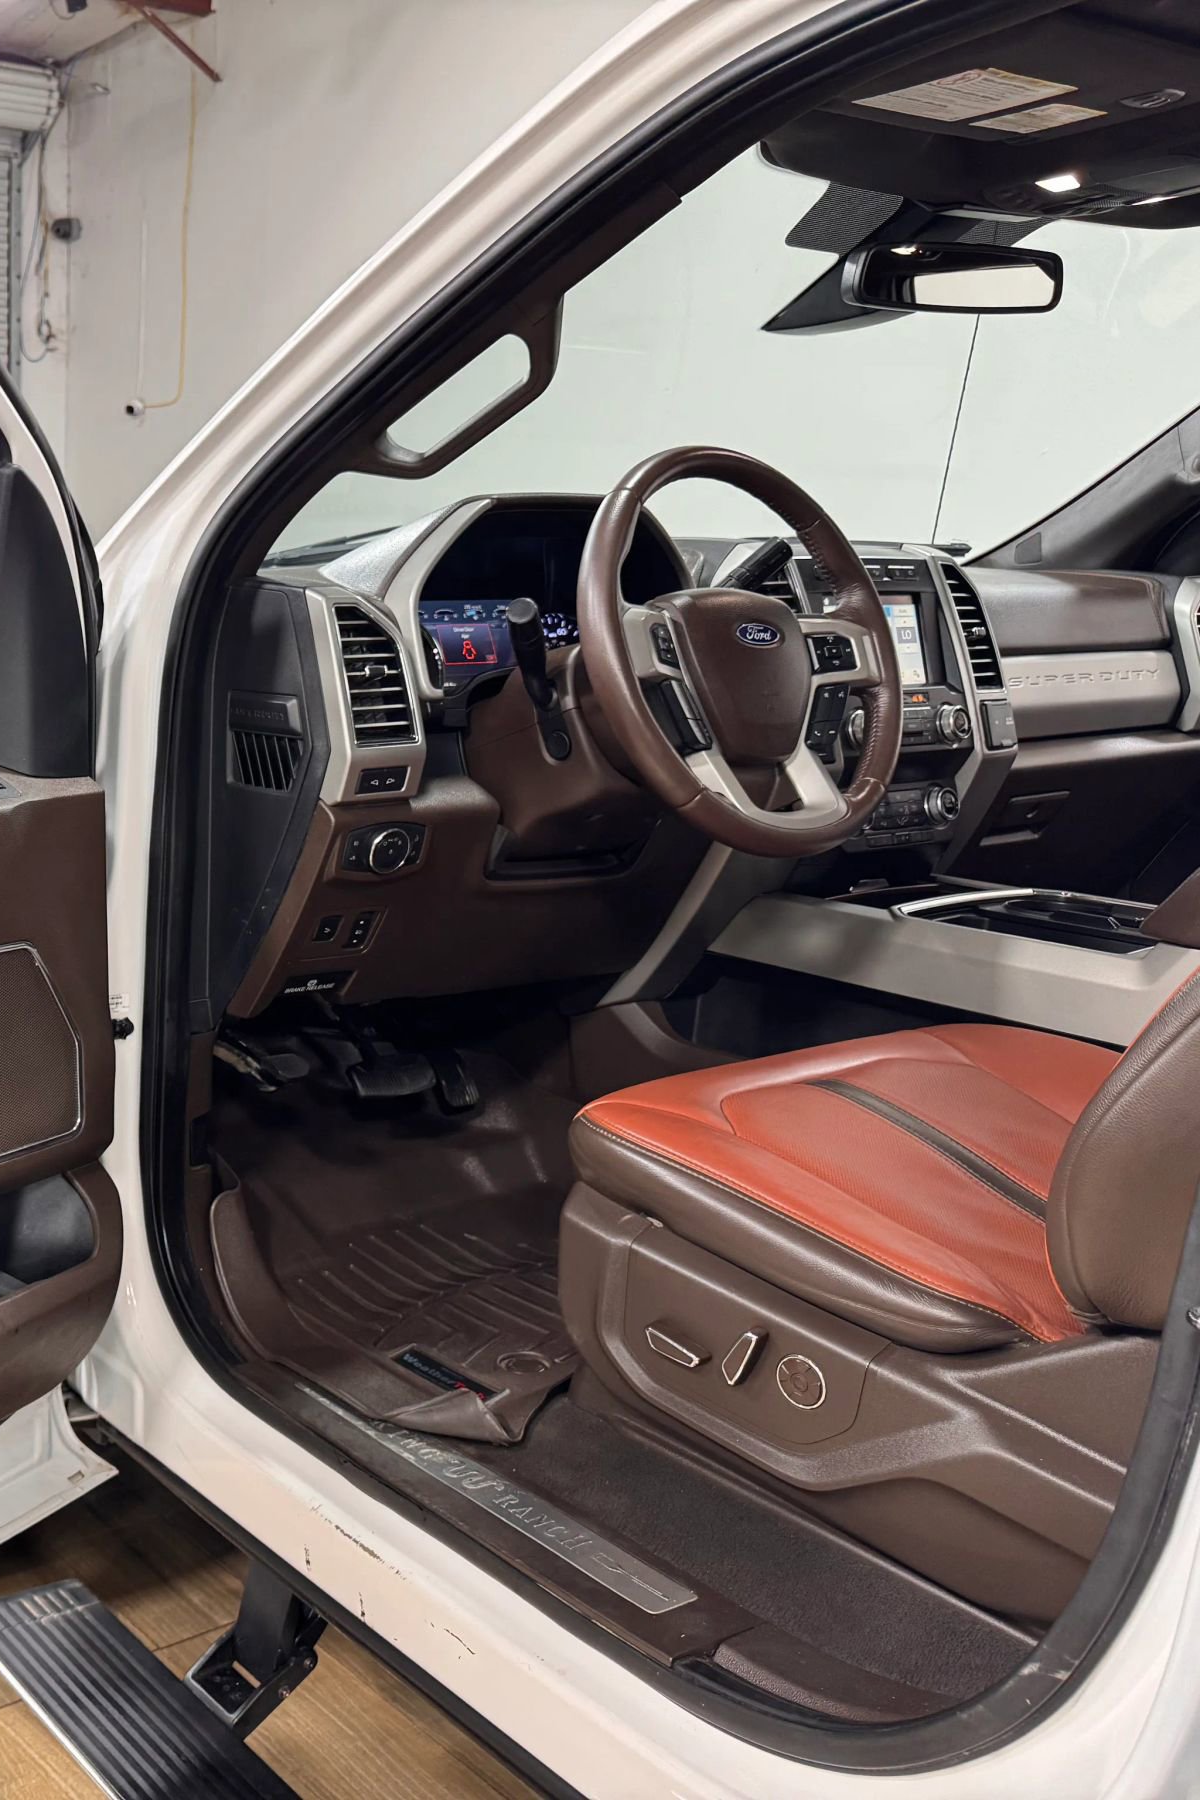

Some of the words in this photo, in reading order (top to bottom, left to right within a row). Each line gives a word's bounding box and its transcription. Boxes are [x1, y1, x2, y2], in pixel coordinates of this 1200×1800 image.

[745, 625, 772, 641] Ford
[901, 630, 912, 640] LO
[1008, 672, 1094, 688] SUPER
[1100, 667, 1159, 682] DUTY
[492, 1495, 593, 1551] RANCH
